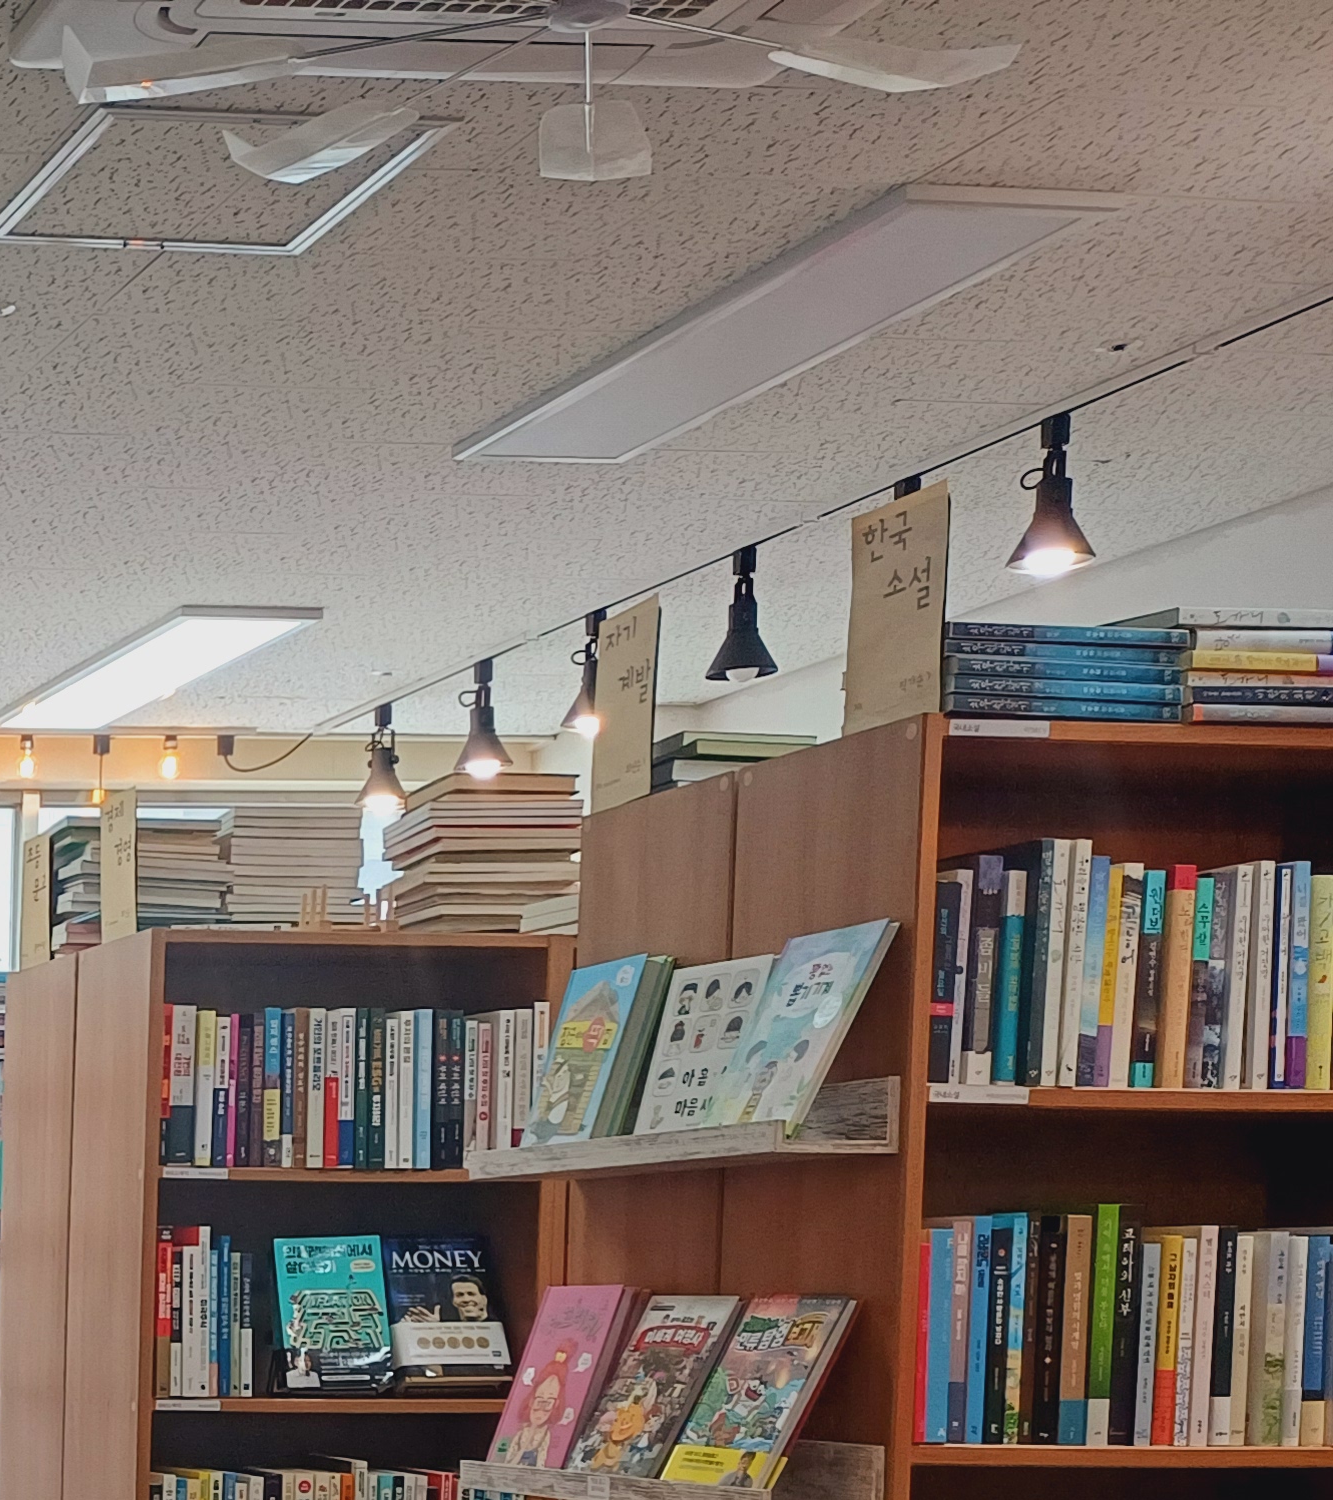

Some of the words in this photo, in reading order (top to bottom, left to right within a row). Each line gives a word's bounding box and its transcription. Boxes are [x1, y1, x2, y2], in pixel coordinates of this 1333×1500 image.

[862, 510, 912, 562] 한국
[882, 556, 932, 611] 소설
[604, 616, 637, 651] 자기
[1053, 879, 1068, 934] 도가니
[673, 1101, 698, 1117] 마음
[391, 1250, 482, 1269] MONEY
